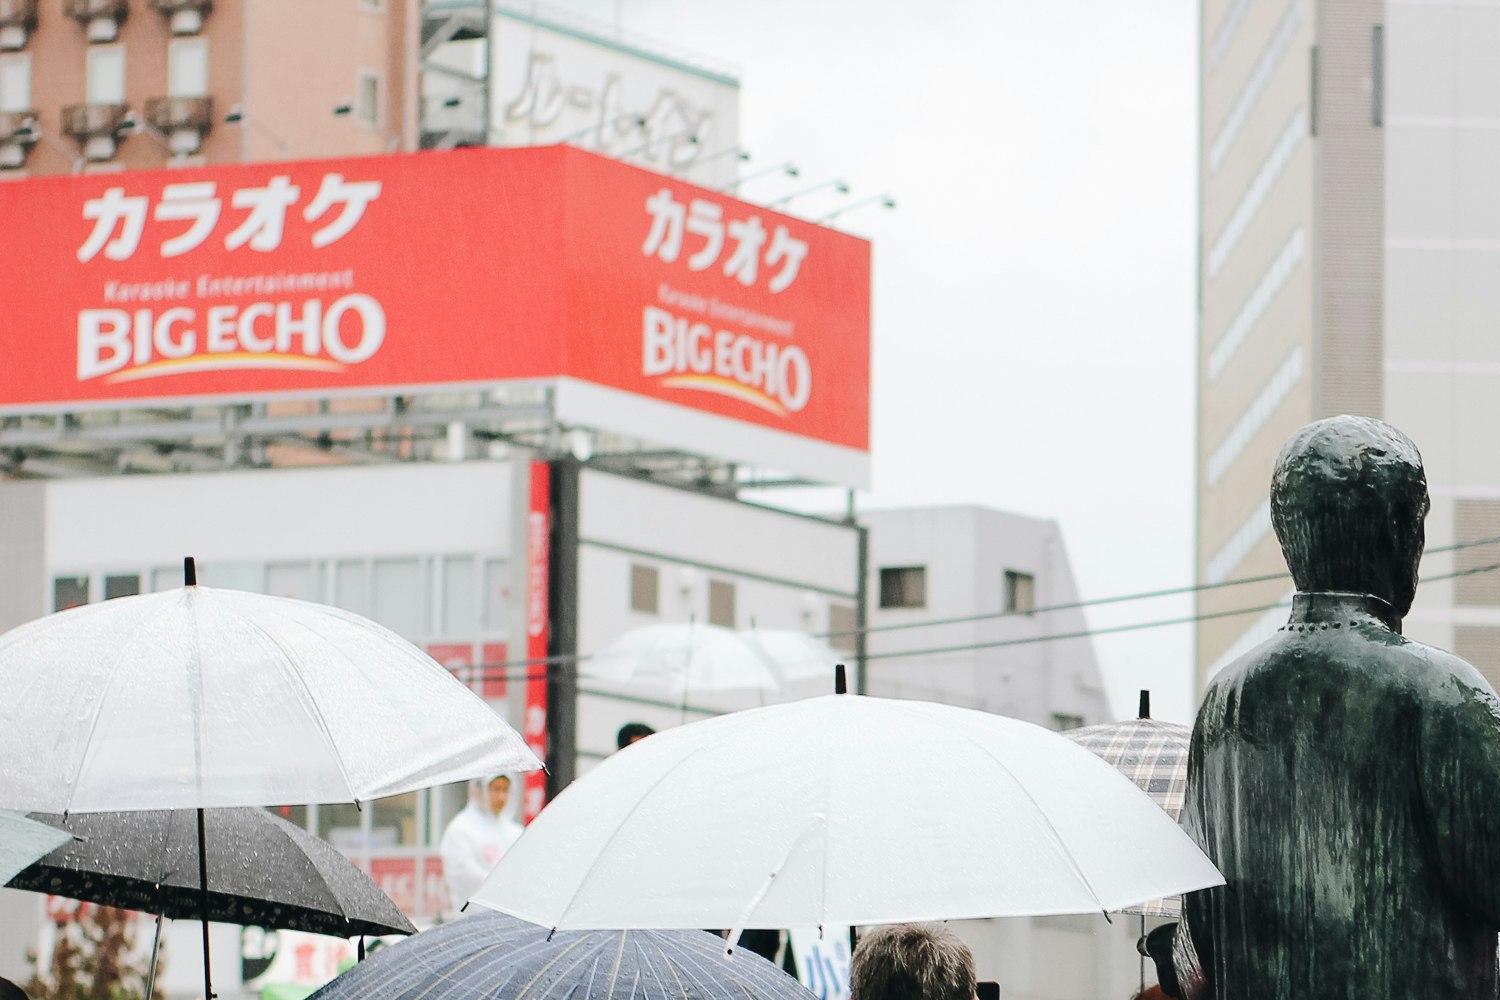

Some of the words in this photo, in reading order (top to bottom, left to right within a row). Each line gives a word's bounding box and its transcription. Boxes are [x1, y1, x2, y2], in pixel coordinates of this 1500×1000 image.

[76, 173, 382, 263] カラオケ
[641, 188, 809, 294] カラオケ
[104, 277, 190, 302] Karaoke
[196, 269, 354, 298] Entertainment
[76, 306, 197, 381] BIG
[206, 292, 387, 364] ECHO
[642, 305, 713, 377] BIG
[714, 329, 812, 413] ECHO
